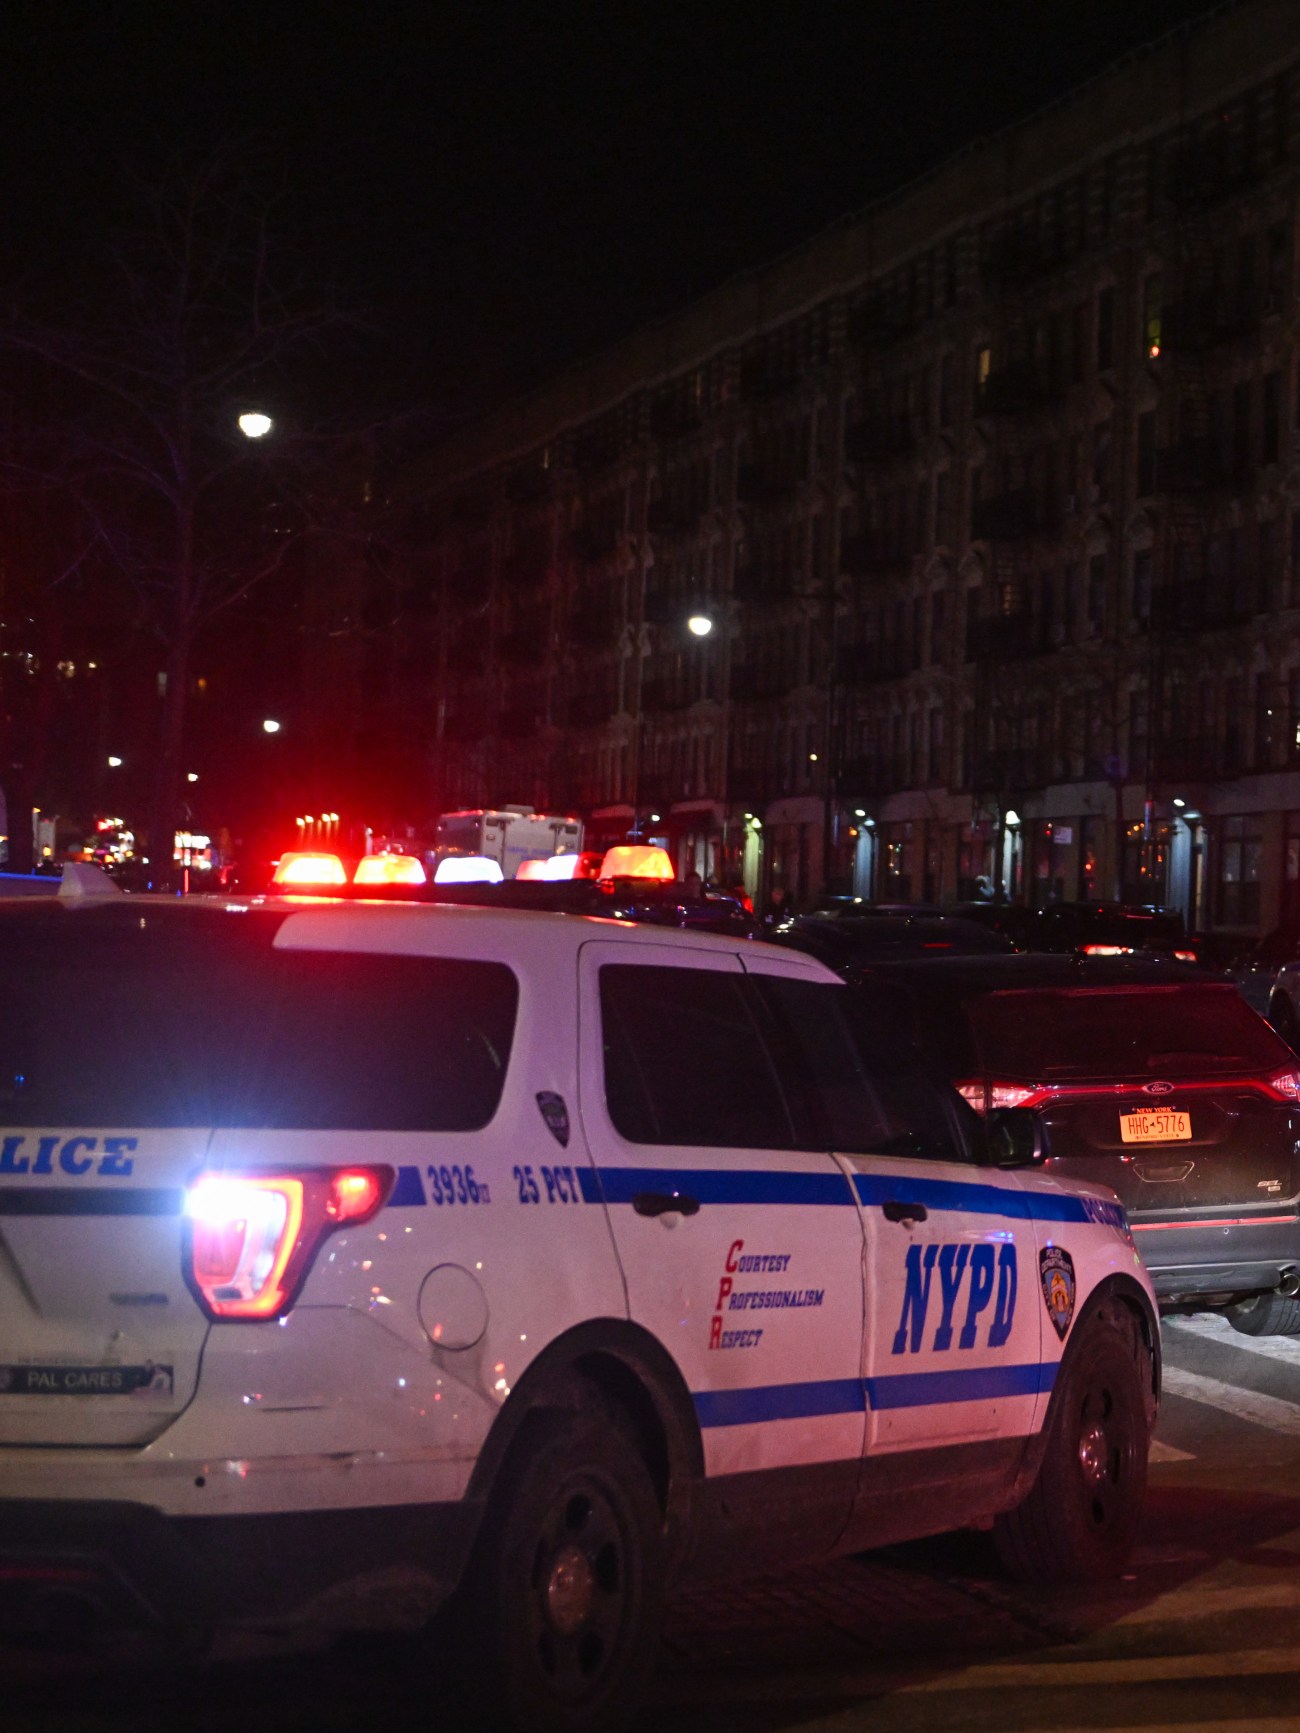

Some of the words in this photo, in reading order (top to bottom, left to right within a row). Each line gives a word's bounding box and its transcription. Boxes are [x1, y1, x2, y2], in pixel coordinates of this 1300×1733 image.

[513, 1165, 539, 1204] 25
[541, 1166, 578, 1204] PCT
[726, 1240, 791, 1272] COURTESY
[716, 1277, 825, 1310] PROFESSIONALISM
[891, 1243, 1017, 1354] NYPD
[709, 1316, 763, 1349] RESPECT
[27, 1371, 58, 1387] PAL
[64, 1371, 123, 1388] CARES
